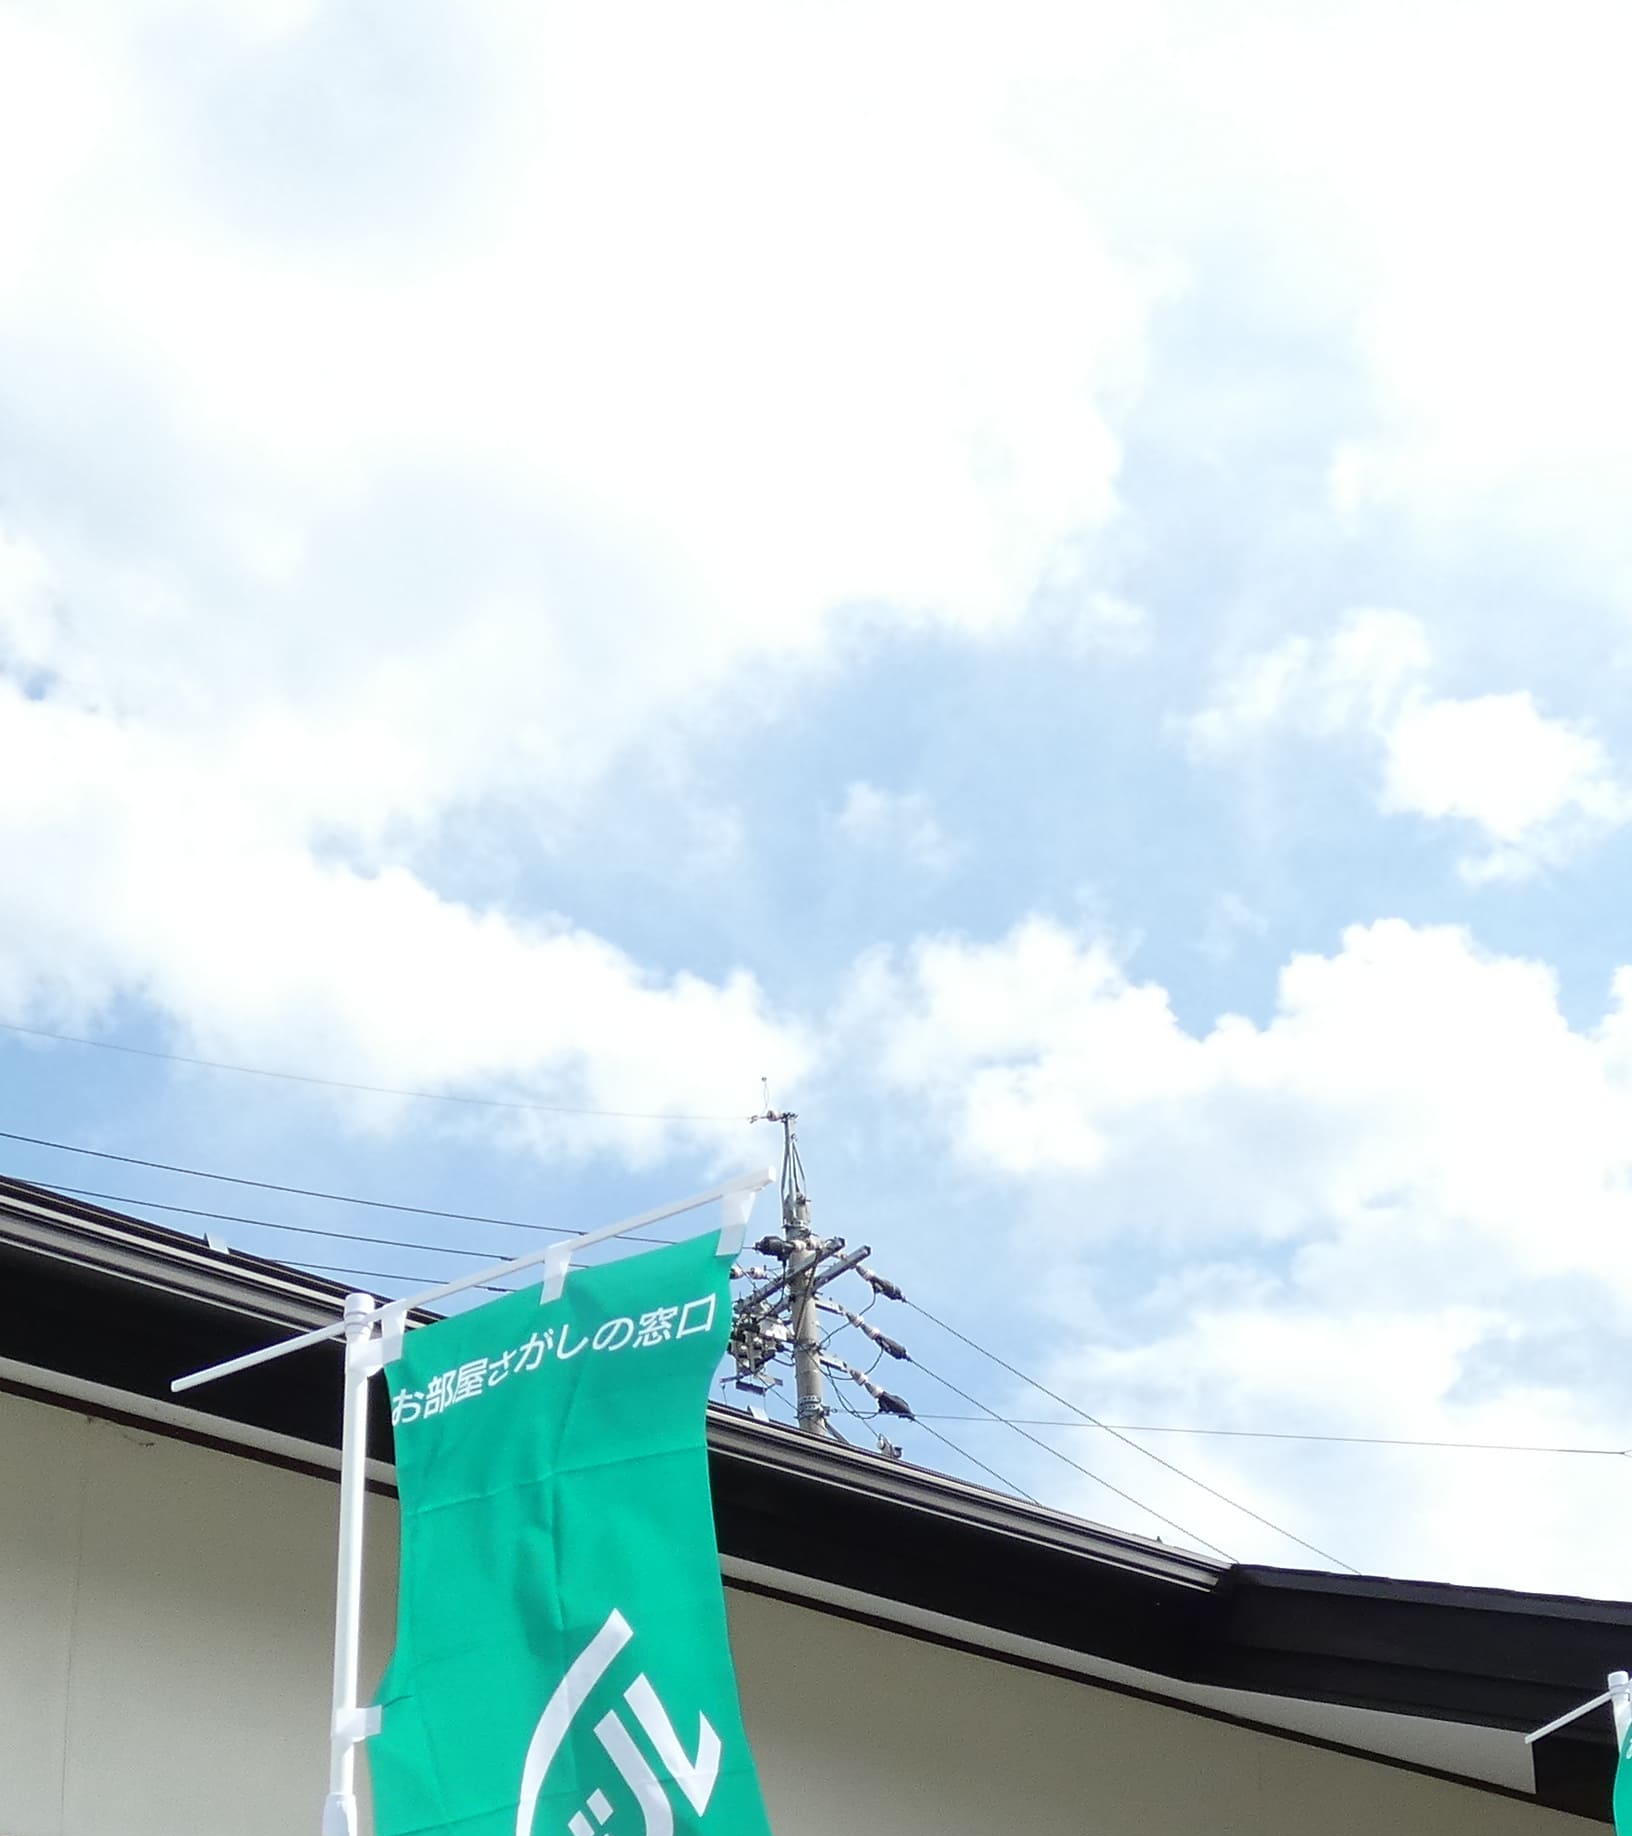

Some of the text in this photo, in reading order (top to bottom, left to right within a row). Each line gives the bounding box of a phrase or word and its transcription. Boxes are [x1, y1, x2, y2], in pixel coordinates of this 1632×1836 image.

[391, 1293, 716, 1426] お部屋さがしの窓口
